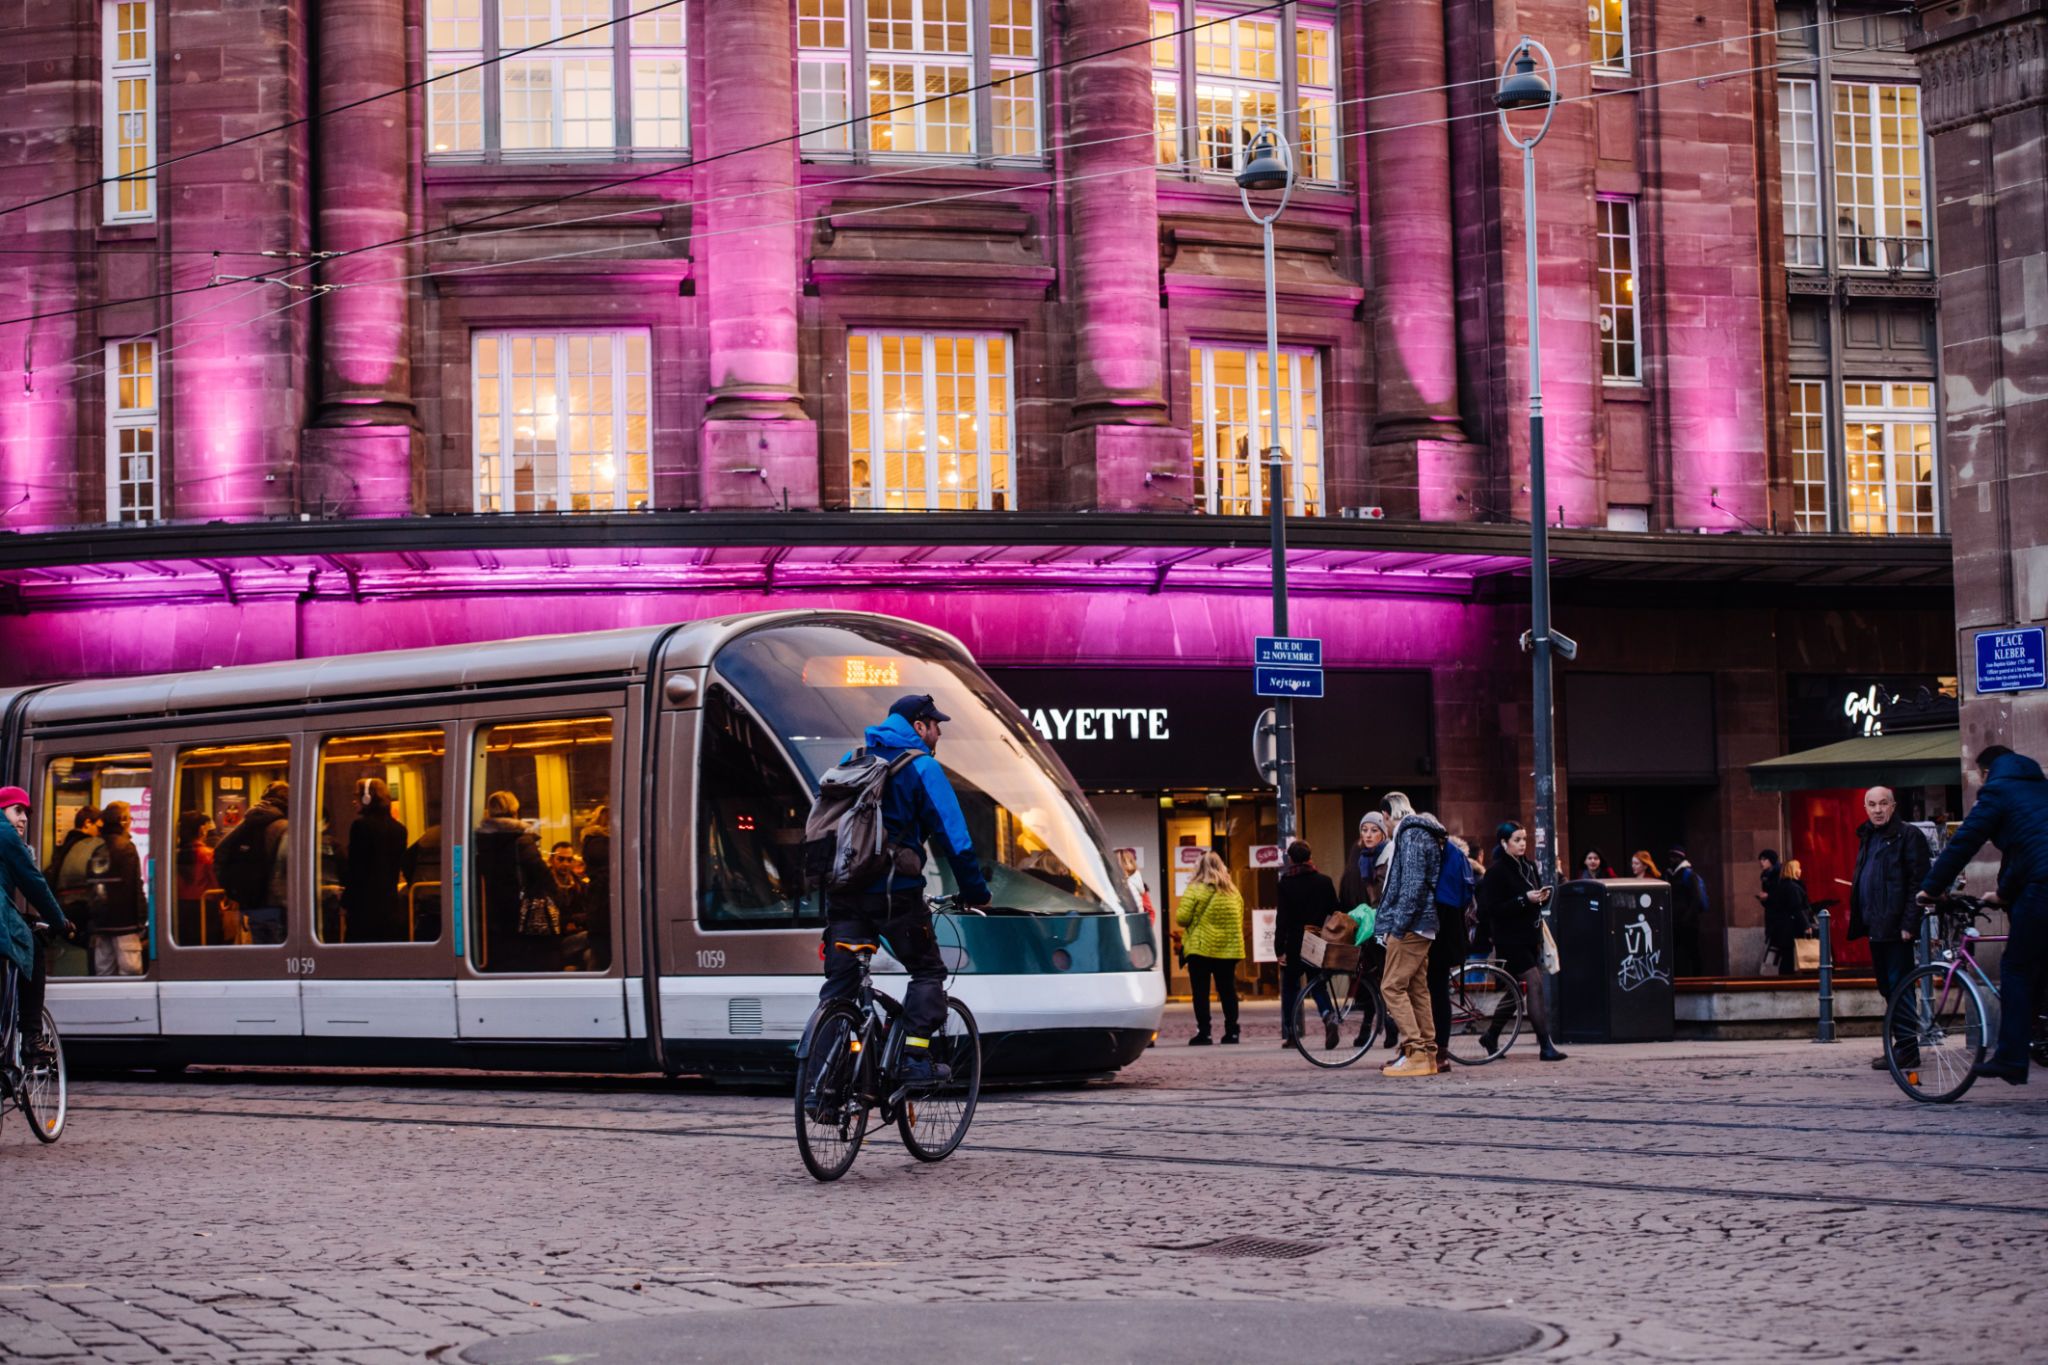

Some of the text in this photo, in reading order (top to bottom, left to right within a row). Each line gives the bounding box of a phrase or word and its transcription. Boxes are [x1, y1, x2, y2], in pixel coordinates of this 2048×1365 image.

[1274, 641, 1303, 651] RUE DU
[1995, 634, 2023, 647] PLACE
[1262, 651, 1314, 661] 22 NOVEMBRE
[1994, 647, 2026, 660] KLEBER
[1270, 677, 1311, 689] Nejstoss
[1020, 708, 1169, 740] AYETTE
[286, 957, 315, 974] 1059
[696, 950, 726, 968] 1059
